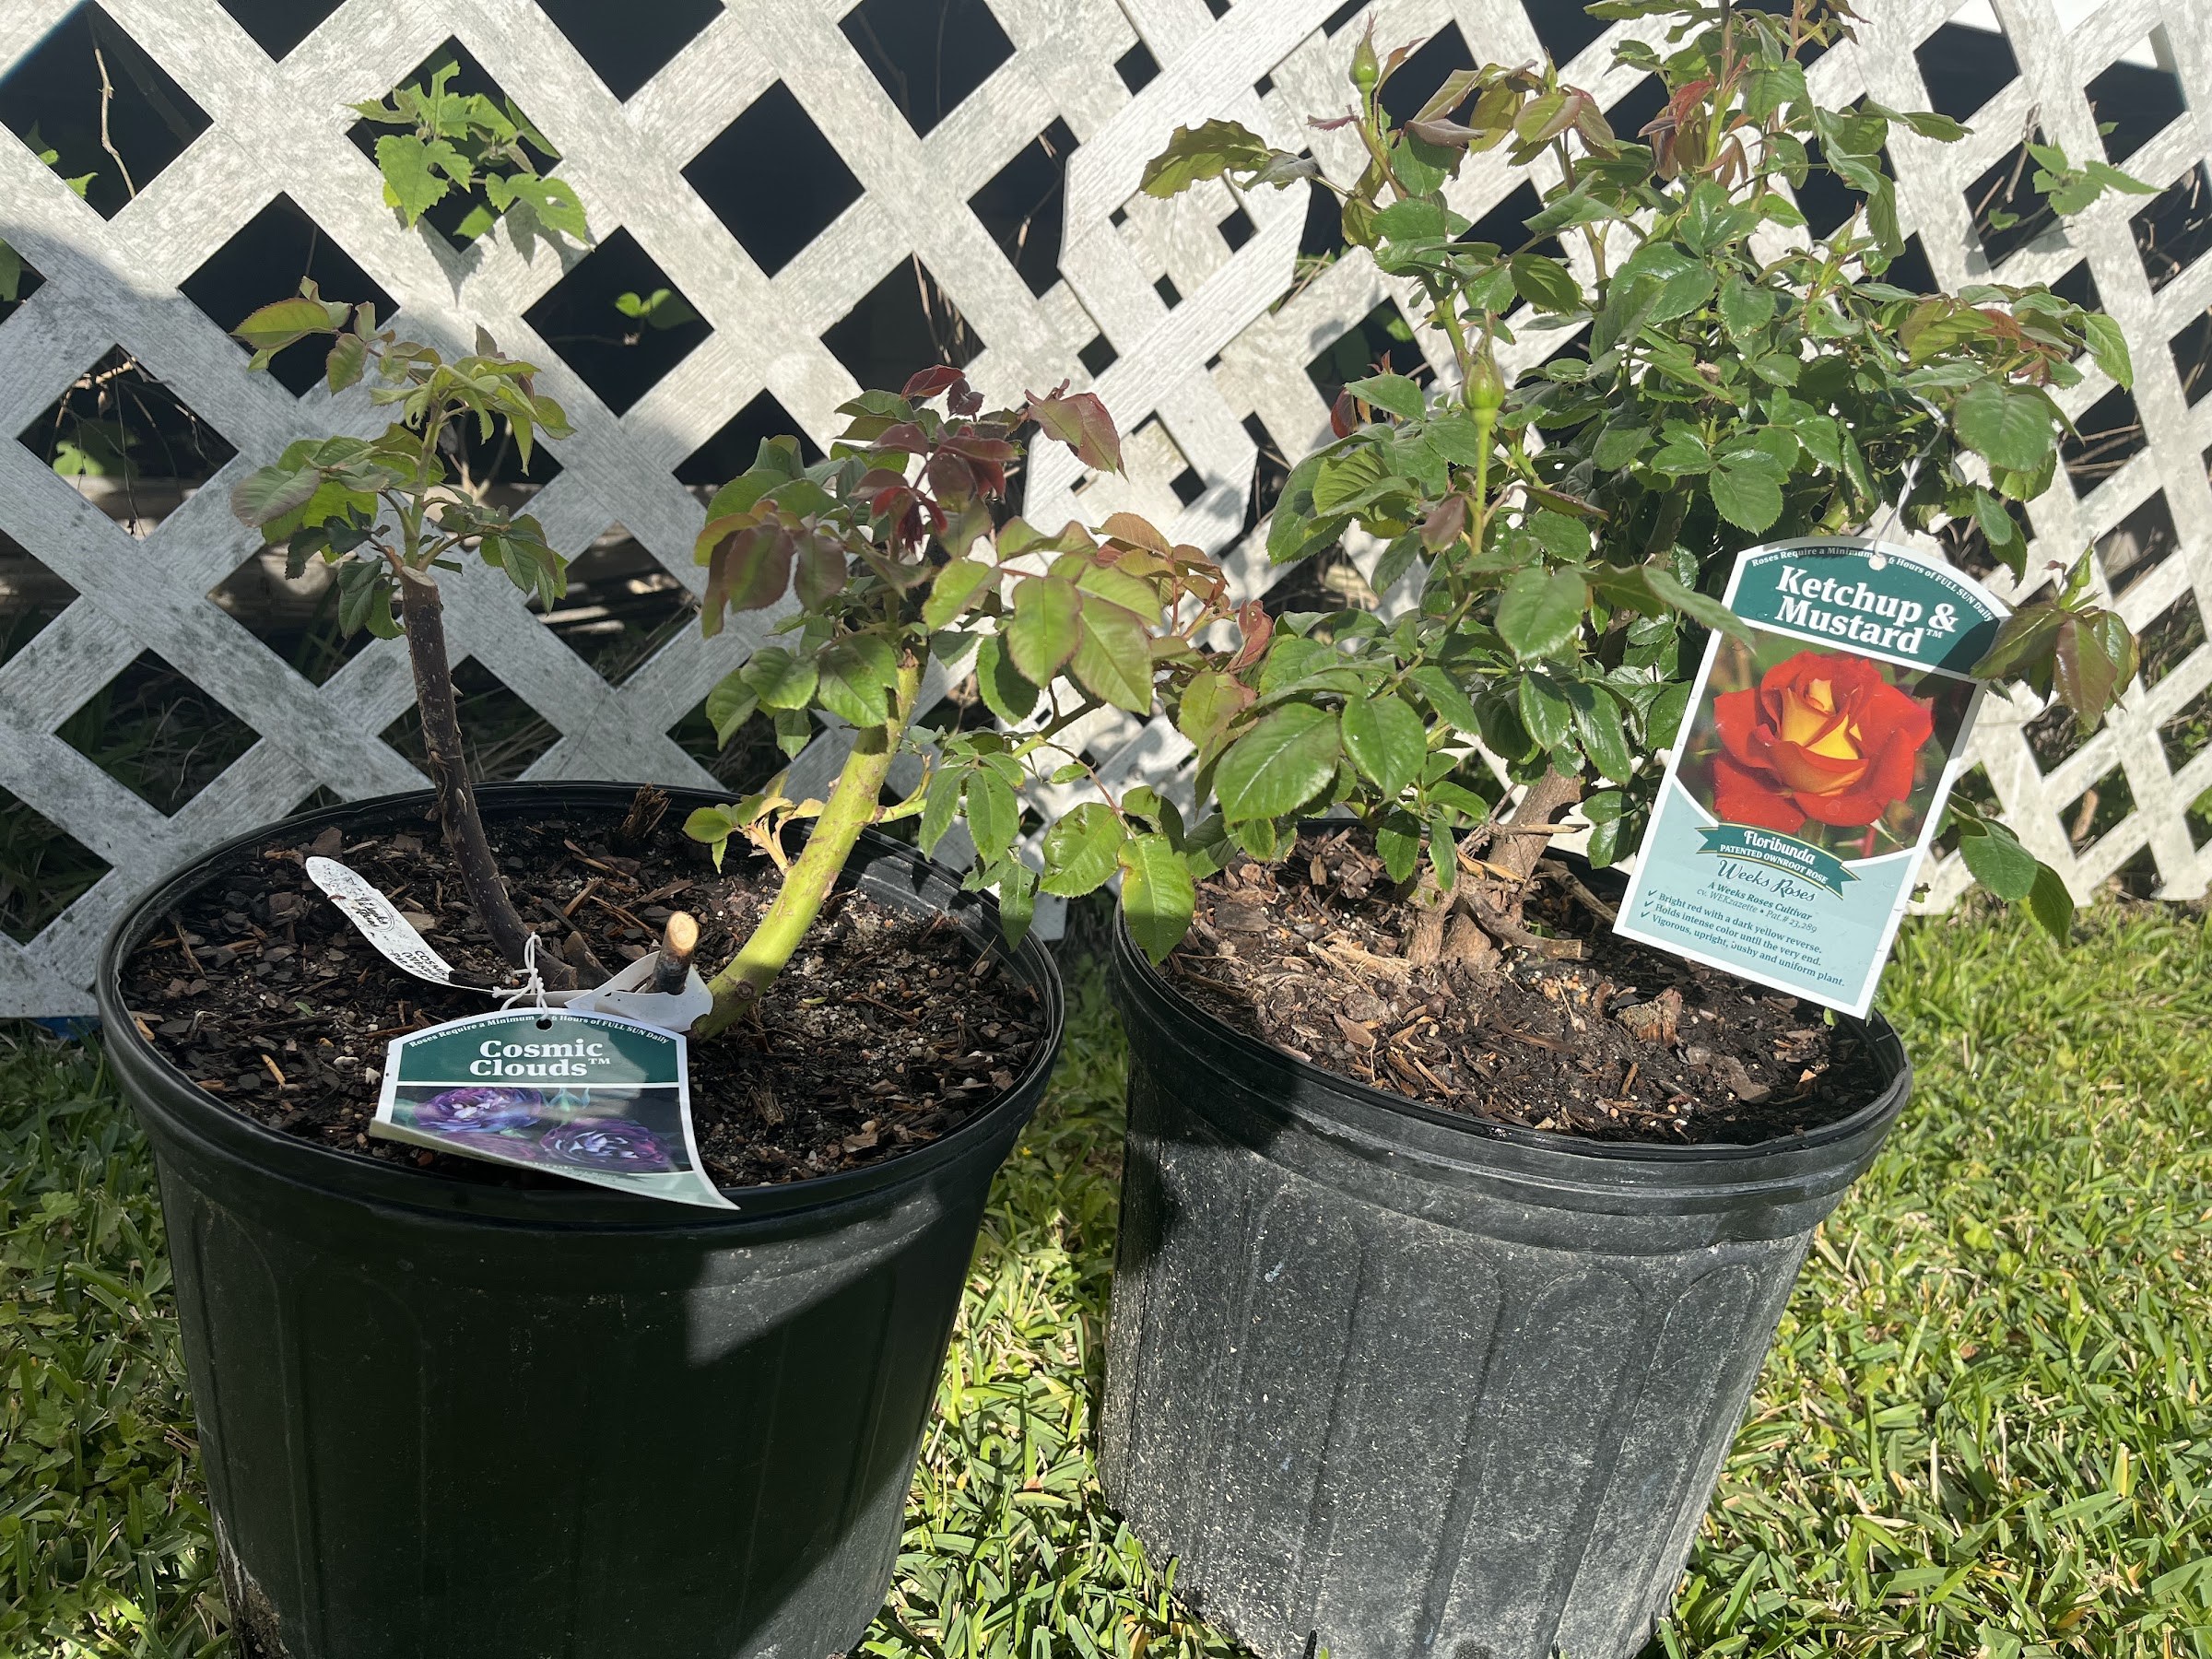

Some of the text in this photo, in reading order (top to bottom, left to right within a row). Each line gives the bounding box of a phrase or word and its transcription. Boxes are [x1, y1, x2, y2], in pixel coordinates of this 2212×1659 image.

[1751, 553, 1779, 567] Roses
[1780, 547, 1818, 560] Require
[1827, 547, 1874, 559] Minimum
[1888, 556, 1895, 565] 6
[1896, 558, 1924, 574] Hours
[1924, 570, 1937, 580] of
[1935, 573, 1957, 593] FULL
[1956, 587, 1976, 605] SUN
[1972, 602, 1994, 622] Daily
[1775, 565, 1959, 633] Ketchup &
[1720, 843, 1830, 884] PATENTED OWNROOT ROSE
[1744, 830, 1816, 865] Floribunda
[1707, 881, 1813, 921] A Weeks Roses Cultivar
[1717, 859, 1816, 902] Weeks Roses
[1658, 892, 1687, 908] Bright
[1687, 903, 1703, 913] red
[1704, 909, 1724, 921] with
[1732, 917, 1753, 931] dark
[1754, 925, 1785, 941] yellow
[1785, 935, 1822, 954] reverse.
[1697, 888, 1708, 897] cv.
[1789, 919, 1818, 934] 23,289
[1653, 914, 1845, 987] Vigorous, upright, bushy and uniform plant.
[1655, 903, 1821, 966] Holds intense color until the very end.
[409, 1033, 439, 1048] Roses
[439, 1023, 477, 1039] Require
[487, 1015, 535, 1027] Minimum
[559, 1015, 589, 1024] Hours
[601, 1020, 626, 1030] FULL
[626, 1025, 646, 1036] SUN
[645, 1031, 670, 1045] Daily
[479, 1038, 604, 1059] Cosmic
